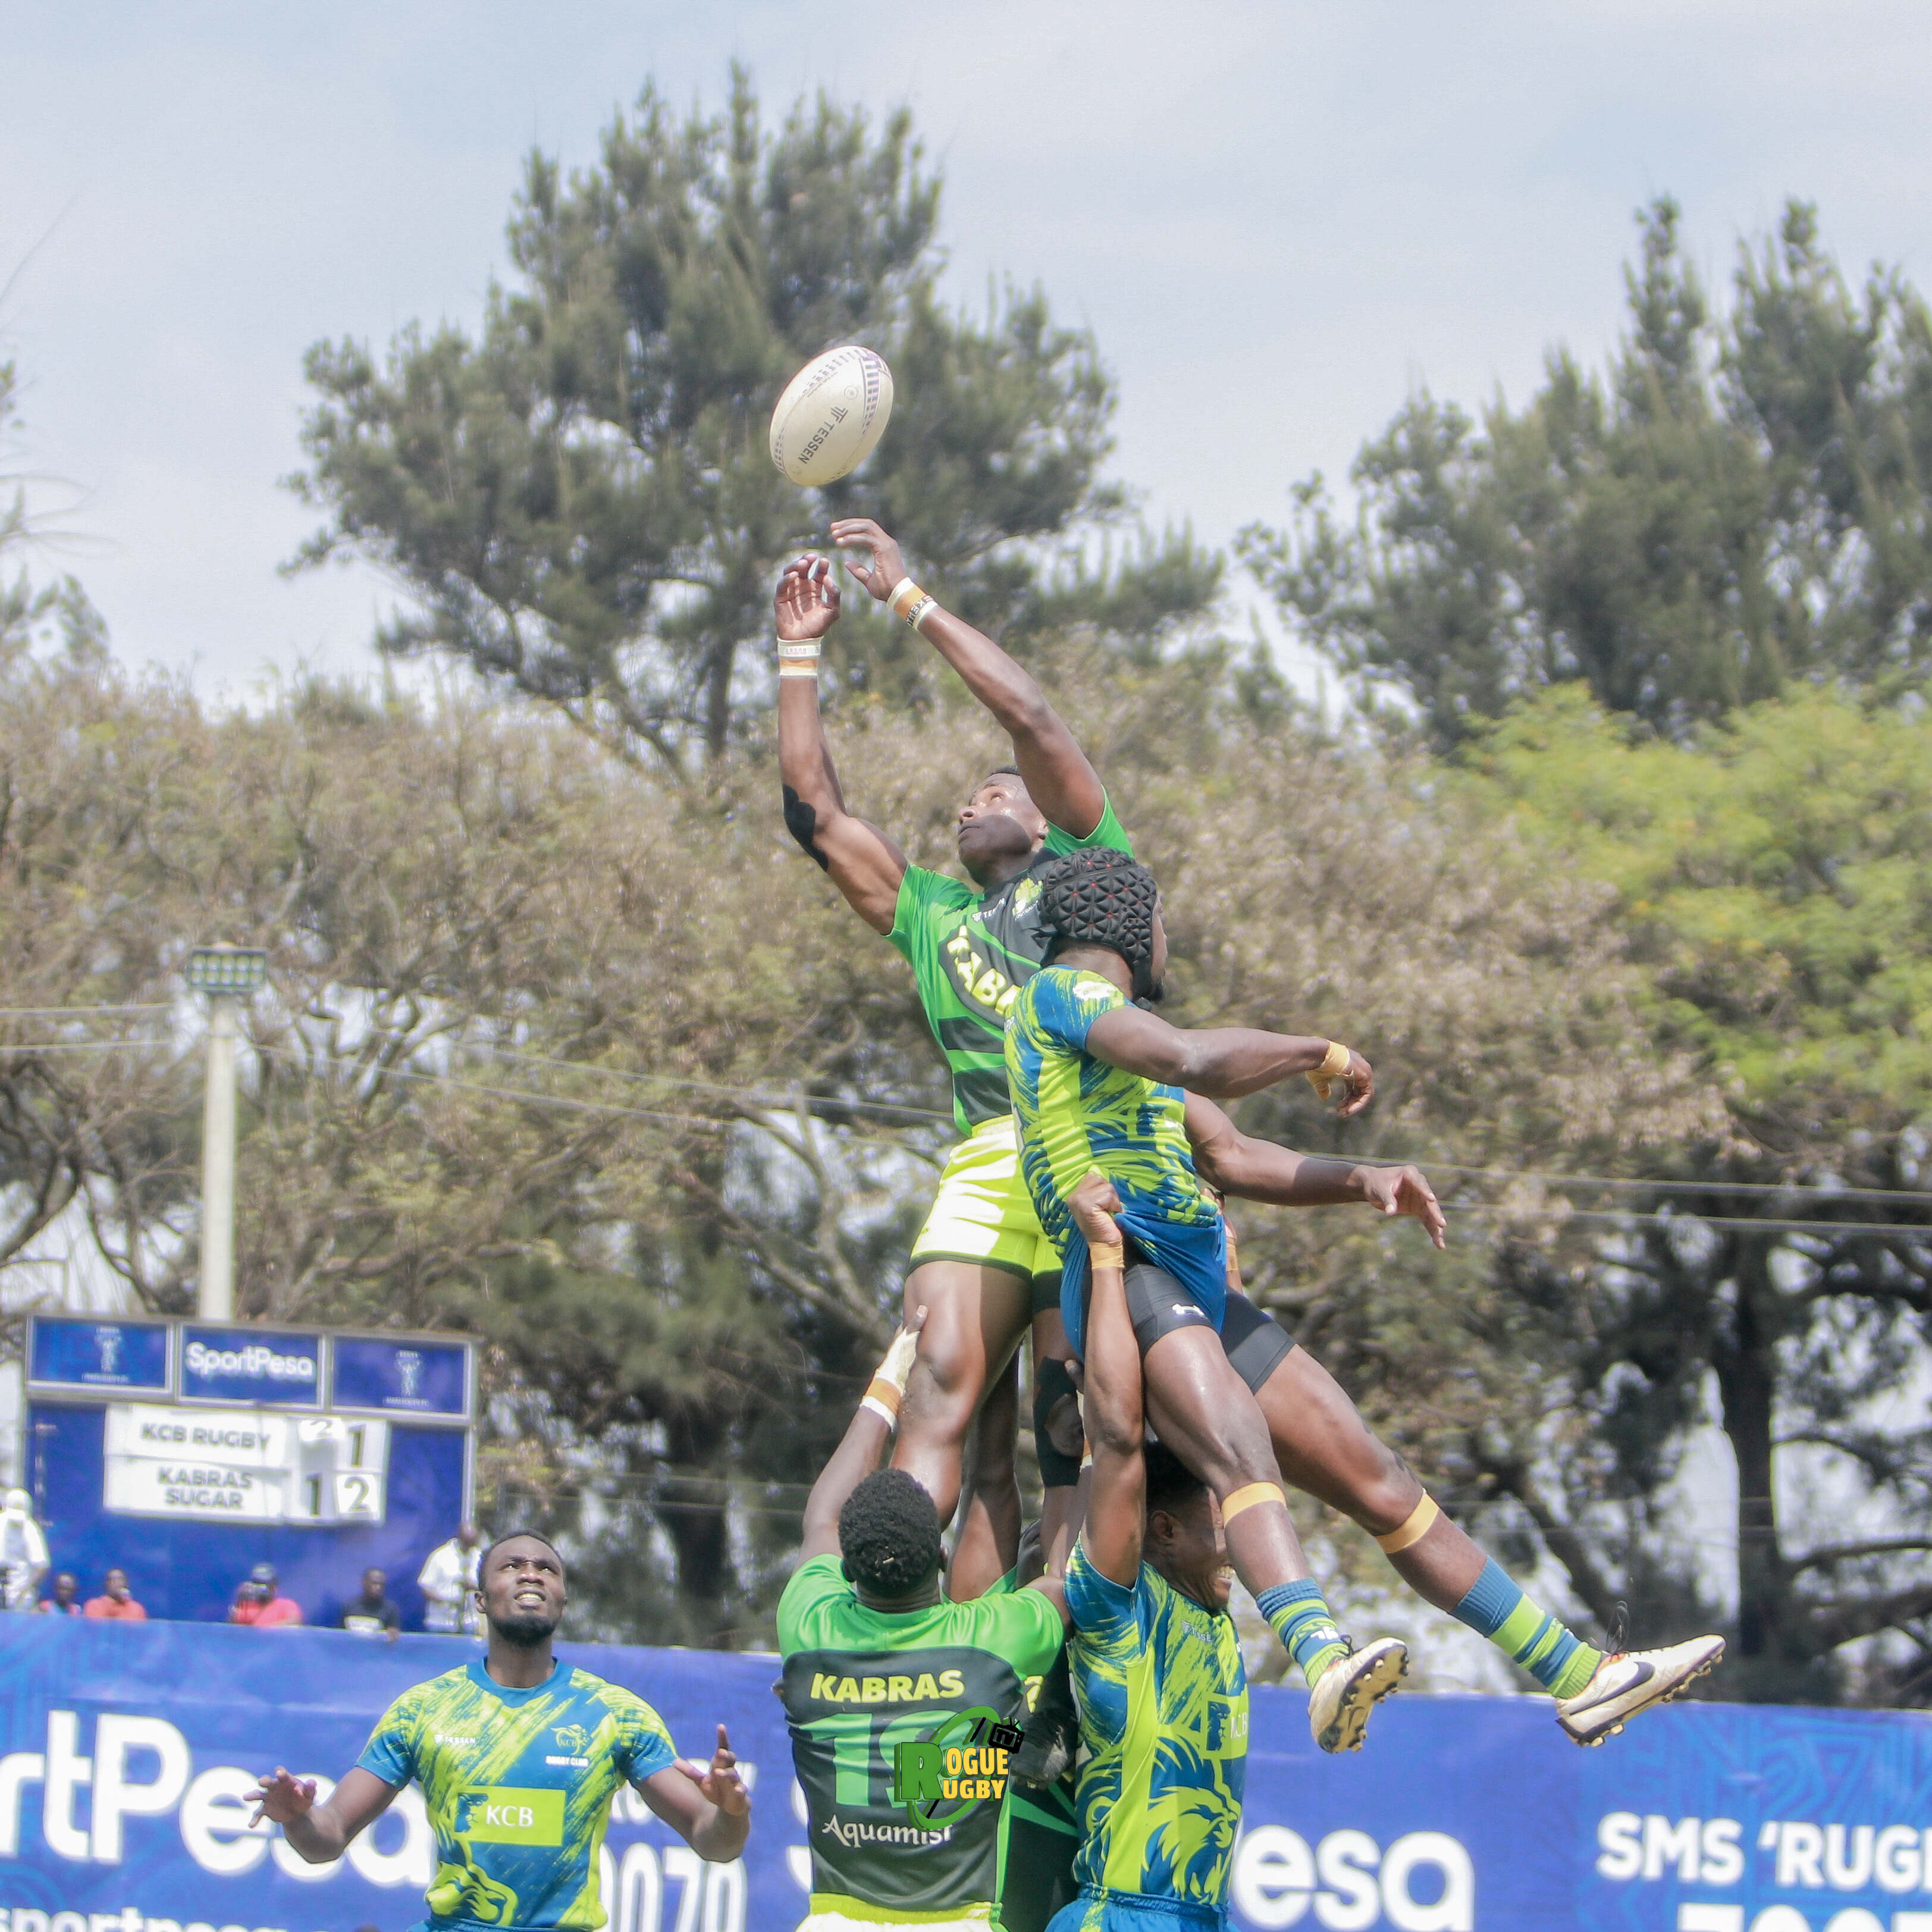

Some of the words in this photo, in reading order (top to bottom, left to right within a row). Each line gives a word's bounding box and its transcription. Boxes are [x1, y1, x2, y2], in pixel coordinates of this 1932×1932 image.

[798, 421, 834, 464] TESSEN
[187, 1342, 314, 1378] SportPesa
[141, 1423, 187, 1443] KCB
[192, 1428, 271, 1450] RUGBY
[309, 1417, 333, 1438] 2
[347, 1424, 366, 1467] 1
[158, 1466, 252, 1489] KABRAS
[166, 1488, 243, 1508] SUGAR
[306, 1472, 323, 1516] 1
[344, 1476, 371, 1512] 2
[810, 1669, 966, 1704] KABRAS
[445, 1736, 476, 1744] TESSEN
[485, 1805, 534, 1827] KCB
[1596, 1811, 1746, 1886] SMS
